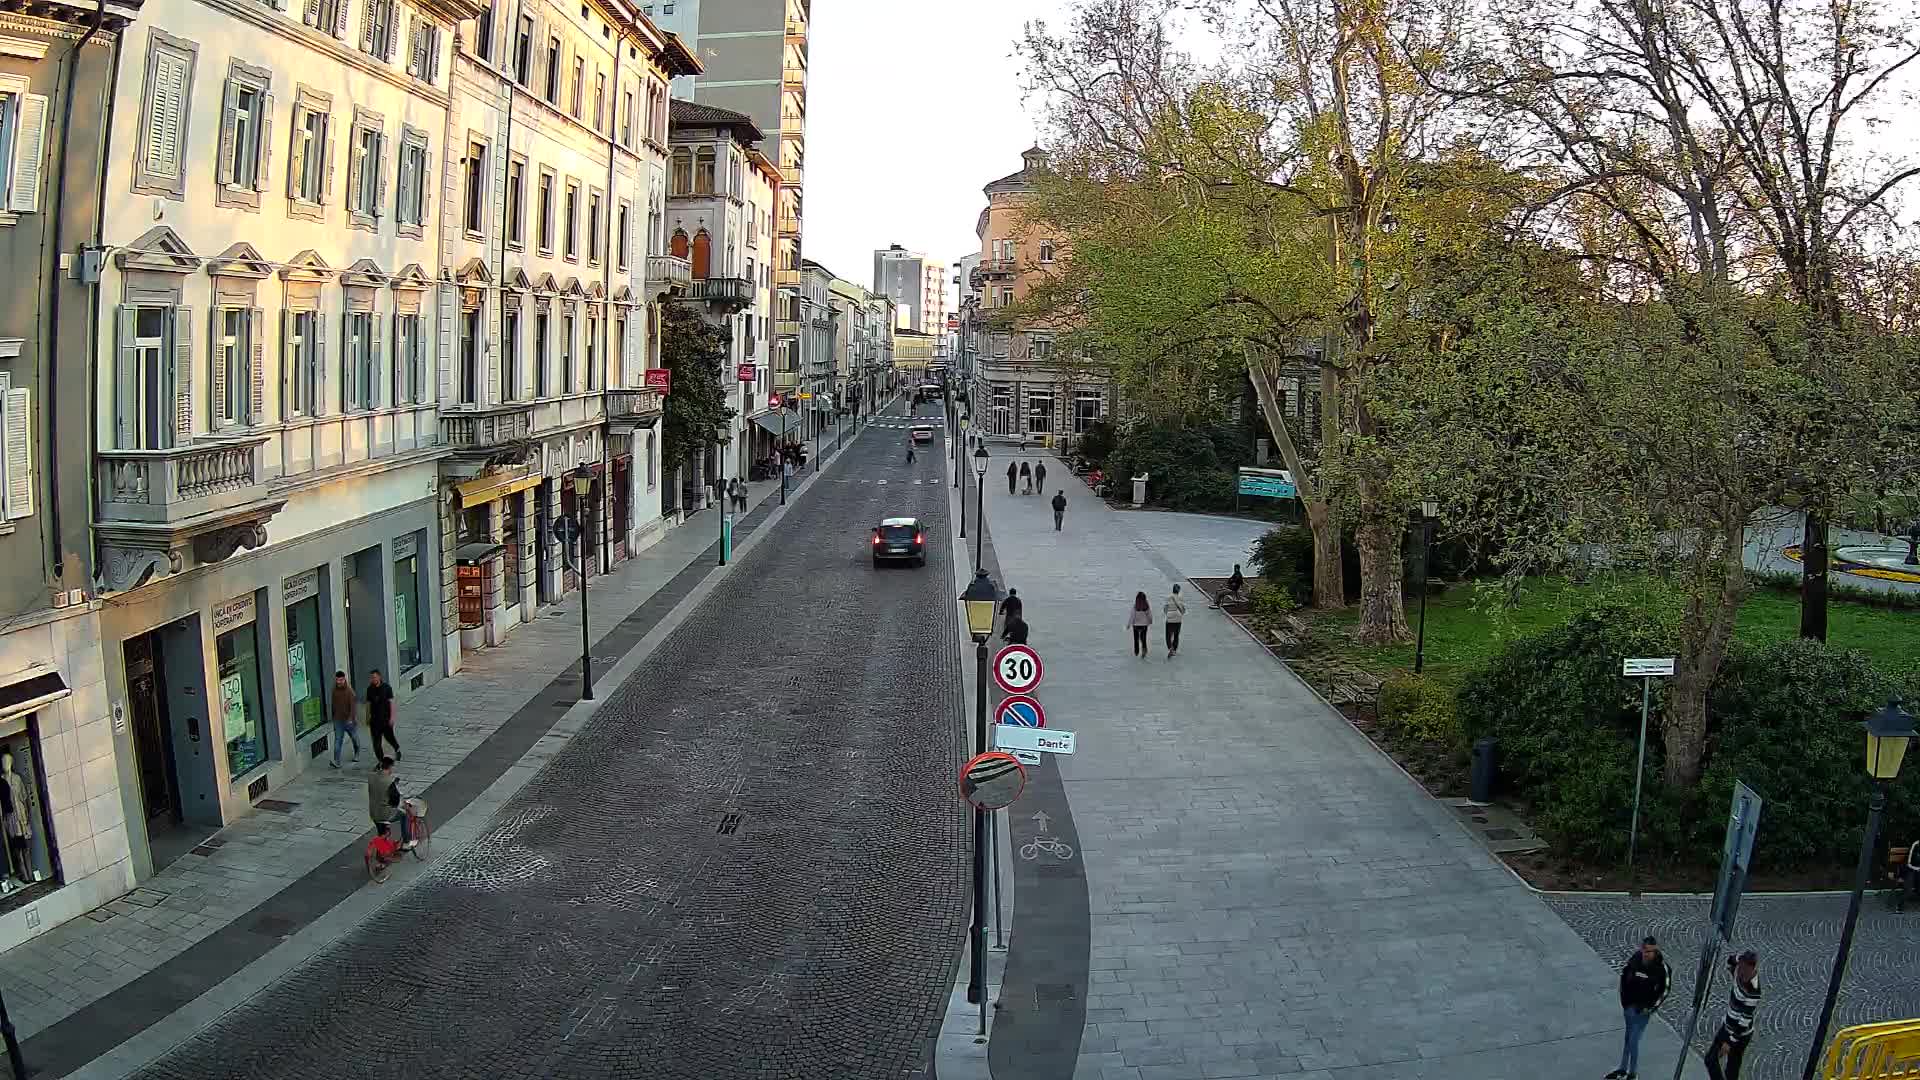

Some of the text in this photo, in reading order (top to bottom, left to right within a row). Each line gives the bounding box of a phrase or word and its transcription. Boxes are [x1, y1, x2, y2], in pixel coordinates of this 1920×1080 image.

[214, 611, 244, 629] OPERATIVO
[1005, 658, 1033, 680] 30
[1037, 738, 1069, 750] Dante
